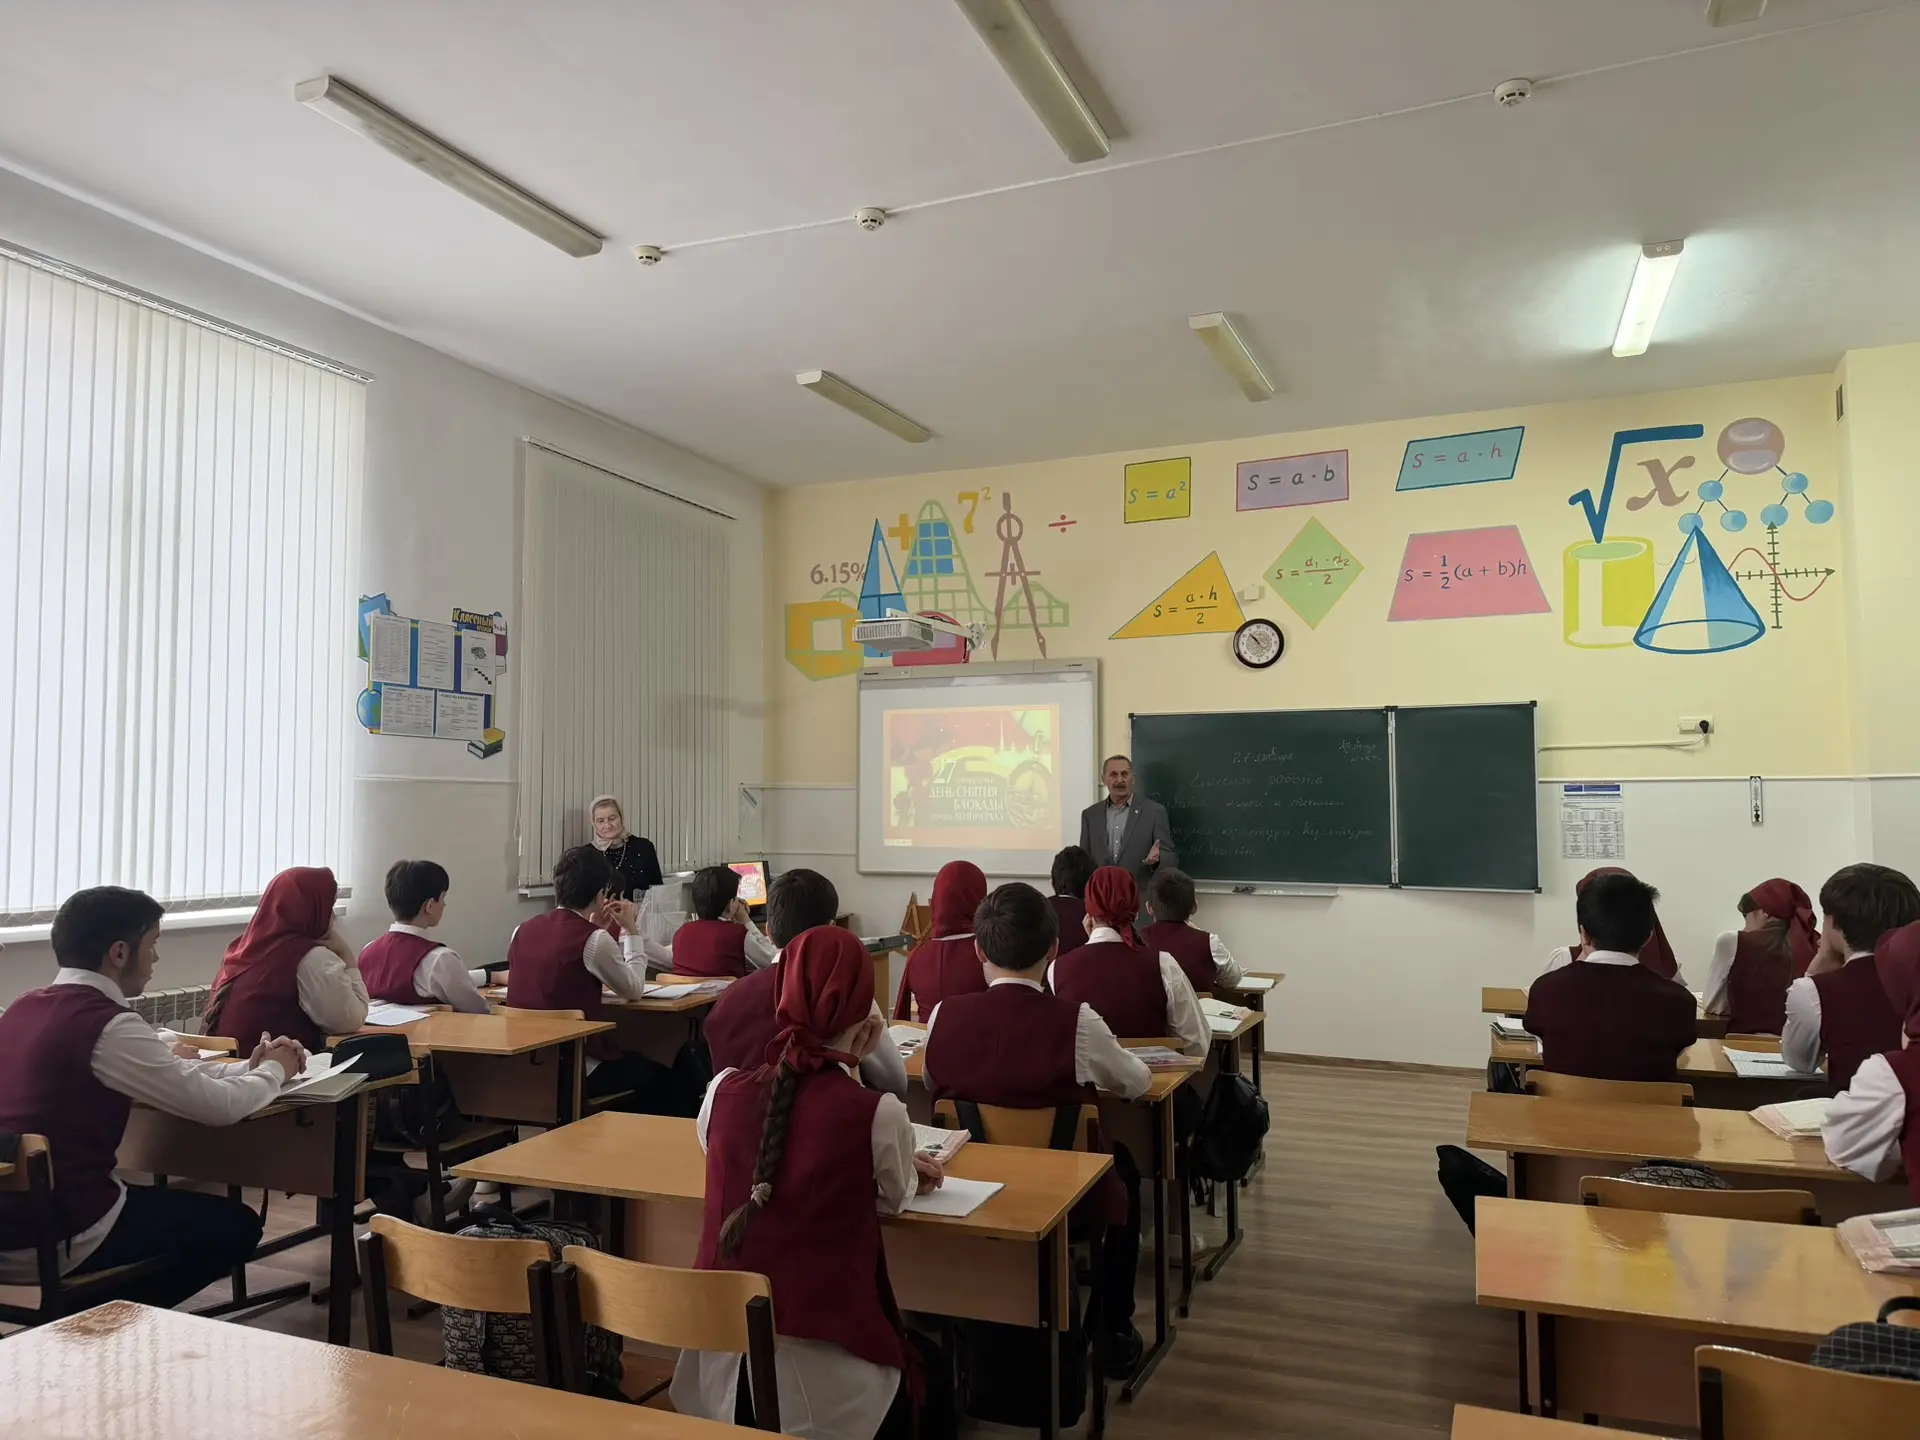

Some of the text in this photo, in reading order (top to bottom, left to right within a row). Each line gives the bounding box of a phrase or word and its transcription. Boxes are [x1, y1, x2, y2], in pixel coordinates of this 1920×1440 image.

[1412, 453, 1424, 470] S
[1247, 474, 1260, 491] S
[1127, 488, 1139, 504] S
[1404, 568, 1414, 582] S
[1153, 604, 1162, 618] S
[932, 758, 957, 784] 27
[928, 785, 998, 799] ДЕНЬ СНЯТИЯ
[953, 798, 1004, 812] БЛОКАДЫ
